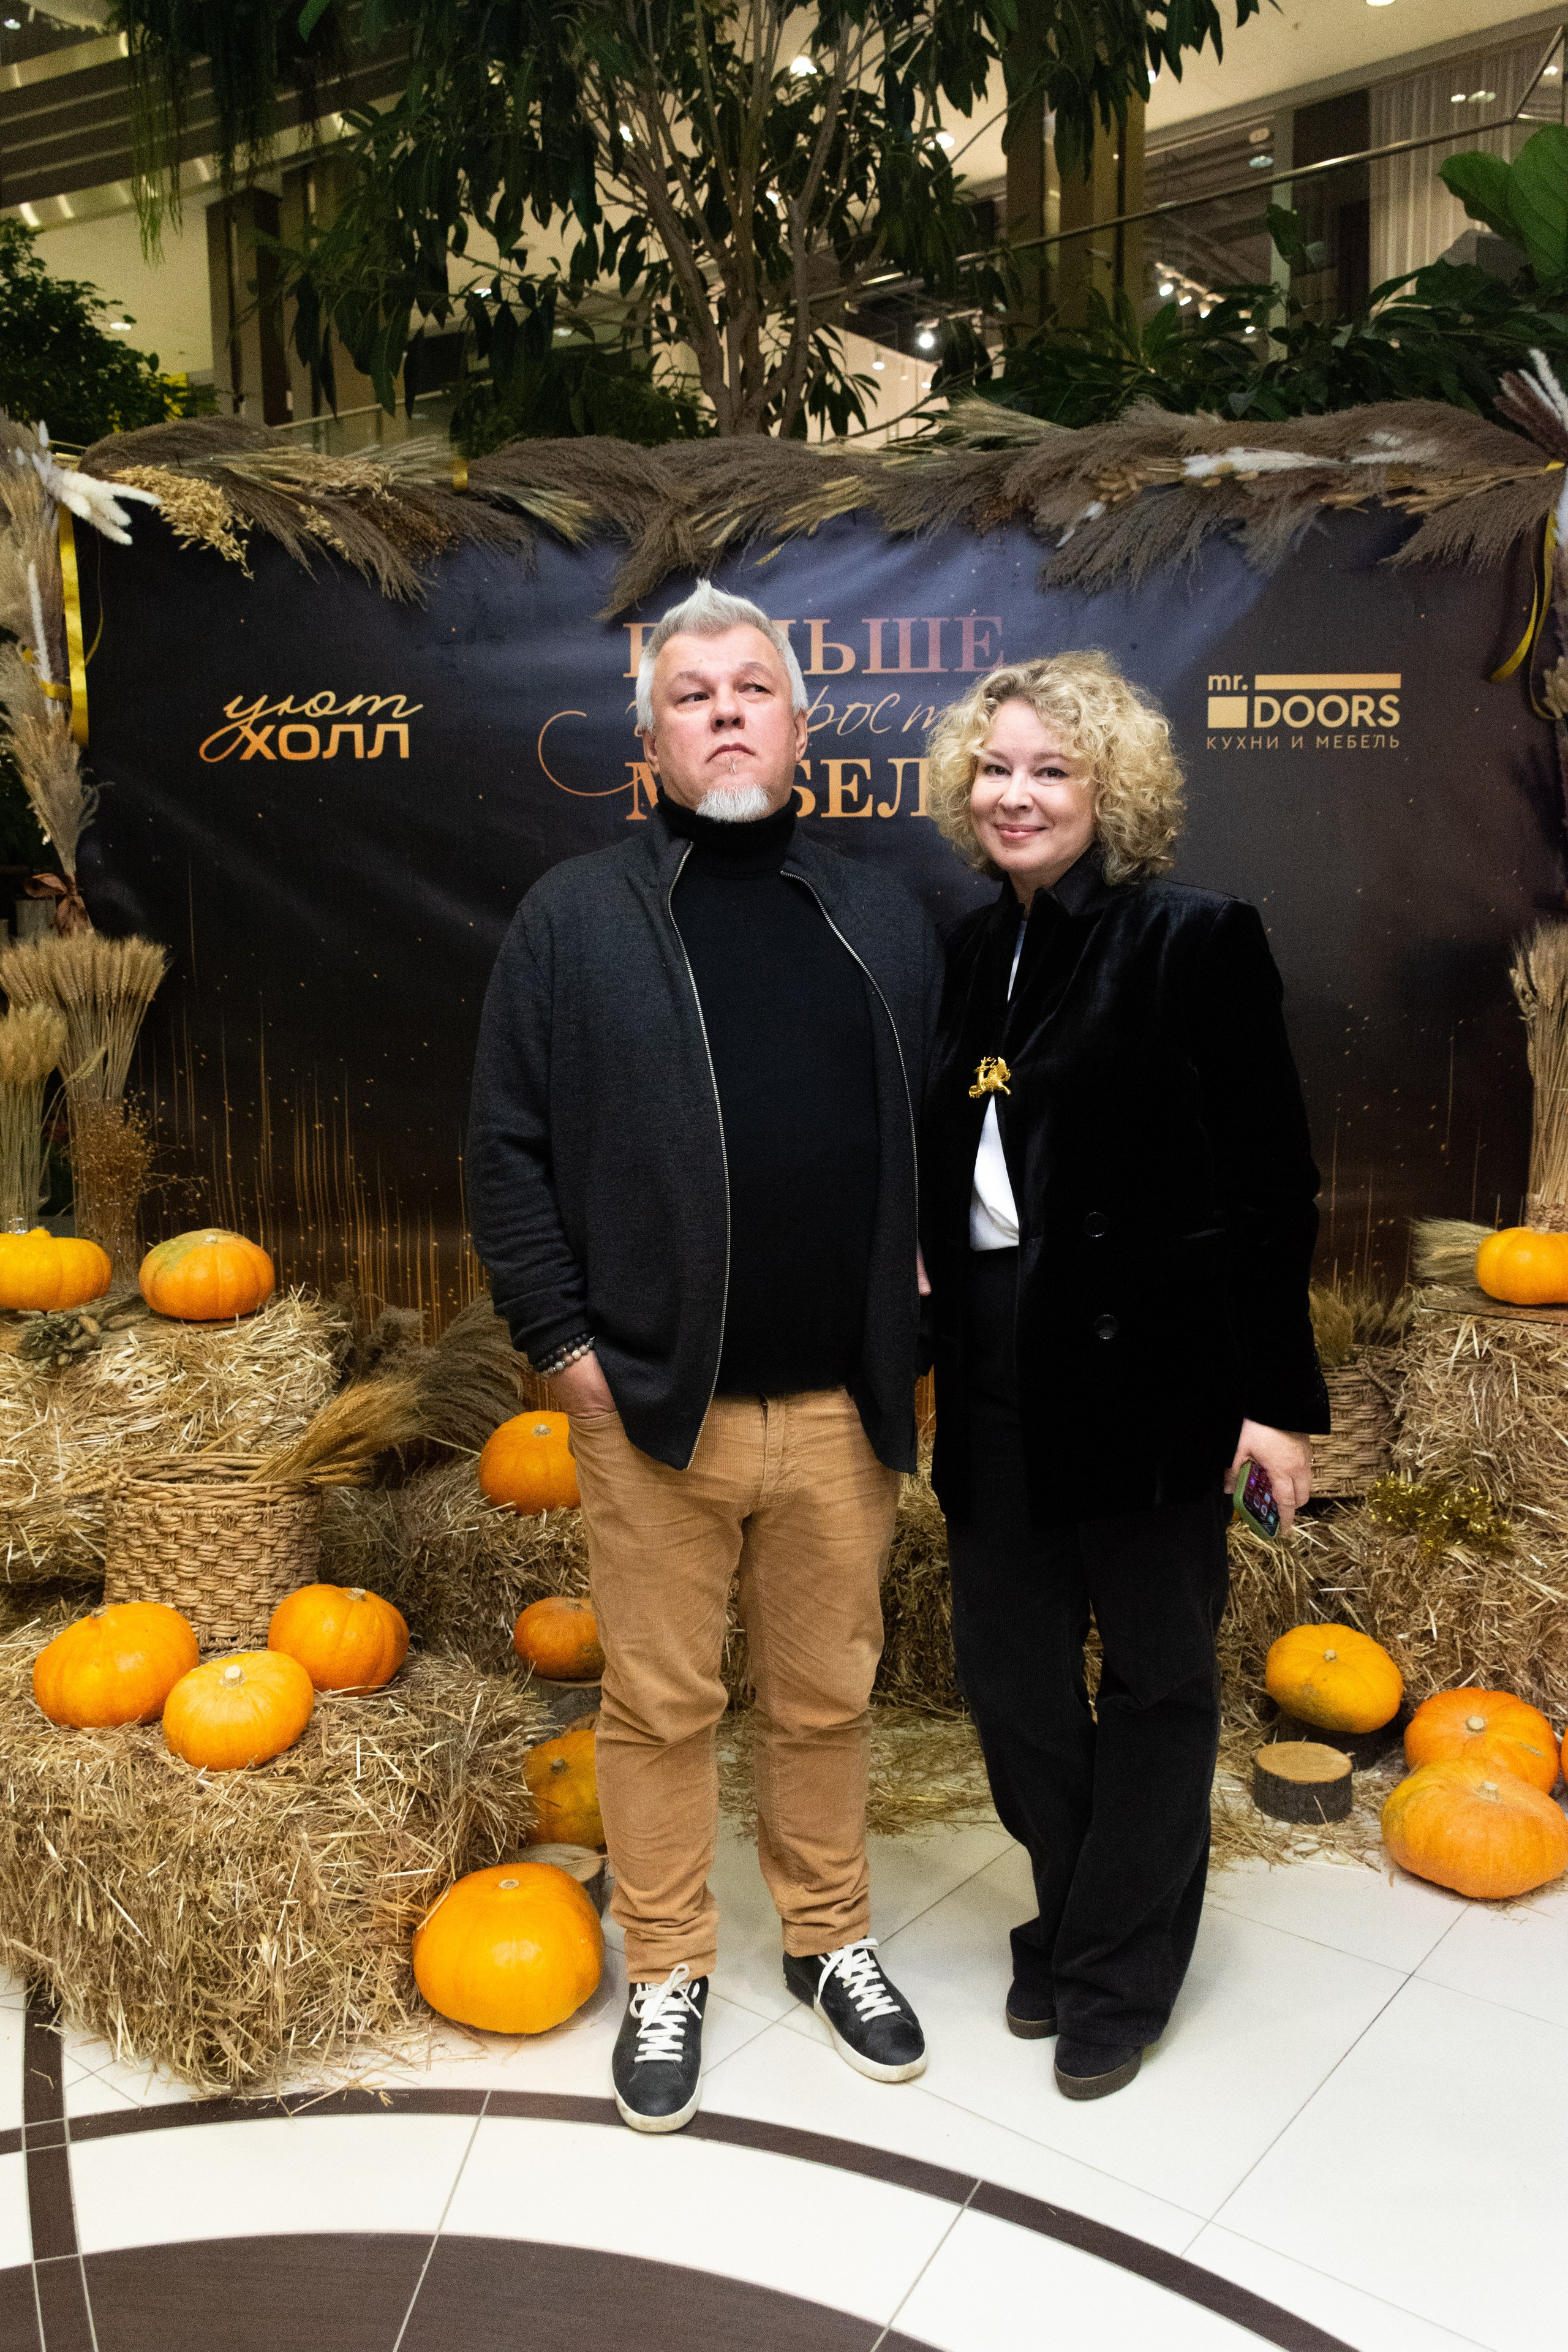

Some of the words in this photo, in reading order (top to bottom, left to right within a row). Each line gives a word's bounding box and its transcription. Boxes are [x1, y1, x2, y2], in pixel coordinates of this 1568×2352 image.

[1208, 674, 1248, 691] mr.
[1254, 695, 1401, 728] DOORS
[239, 723, 410, 761] ХОЛЛ
[1207, 736, 1279, 750] КУХНИ
[1291, 736, 1303, 749] И
[1316, 734, 1400, 749] МЕБЕЛЬ
